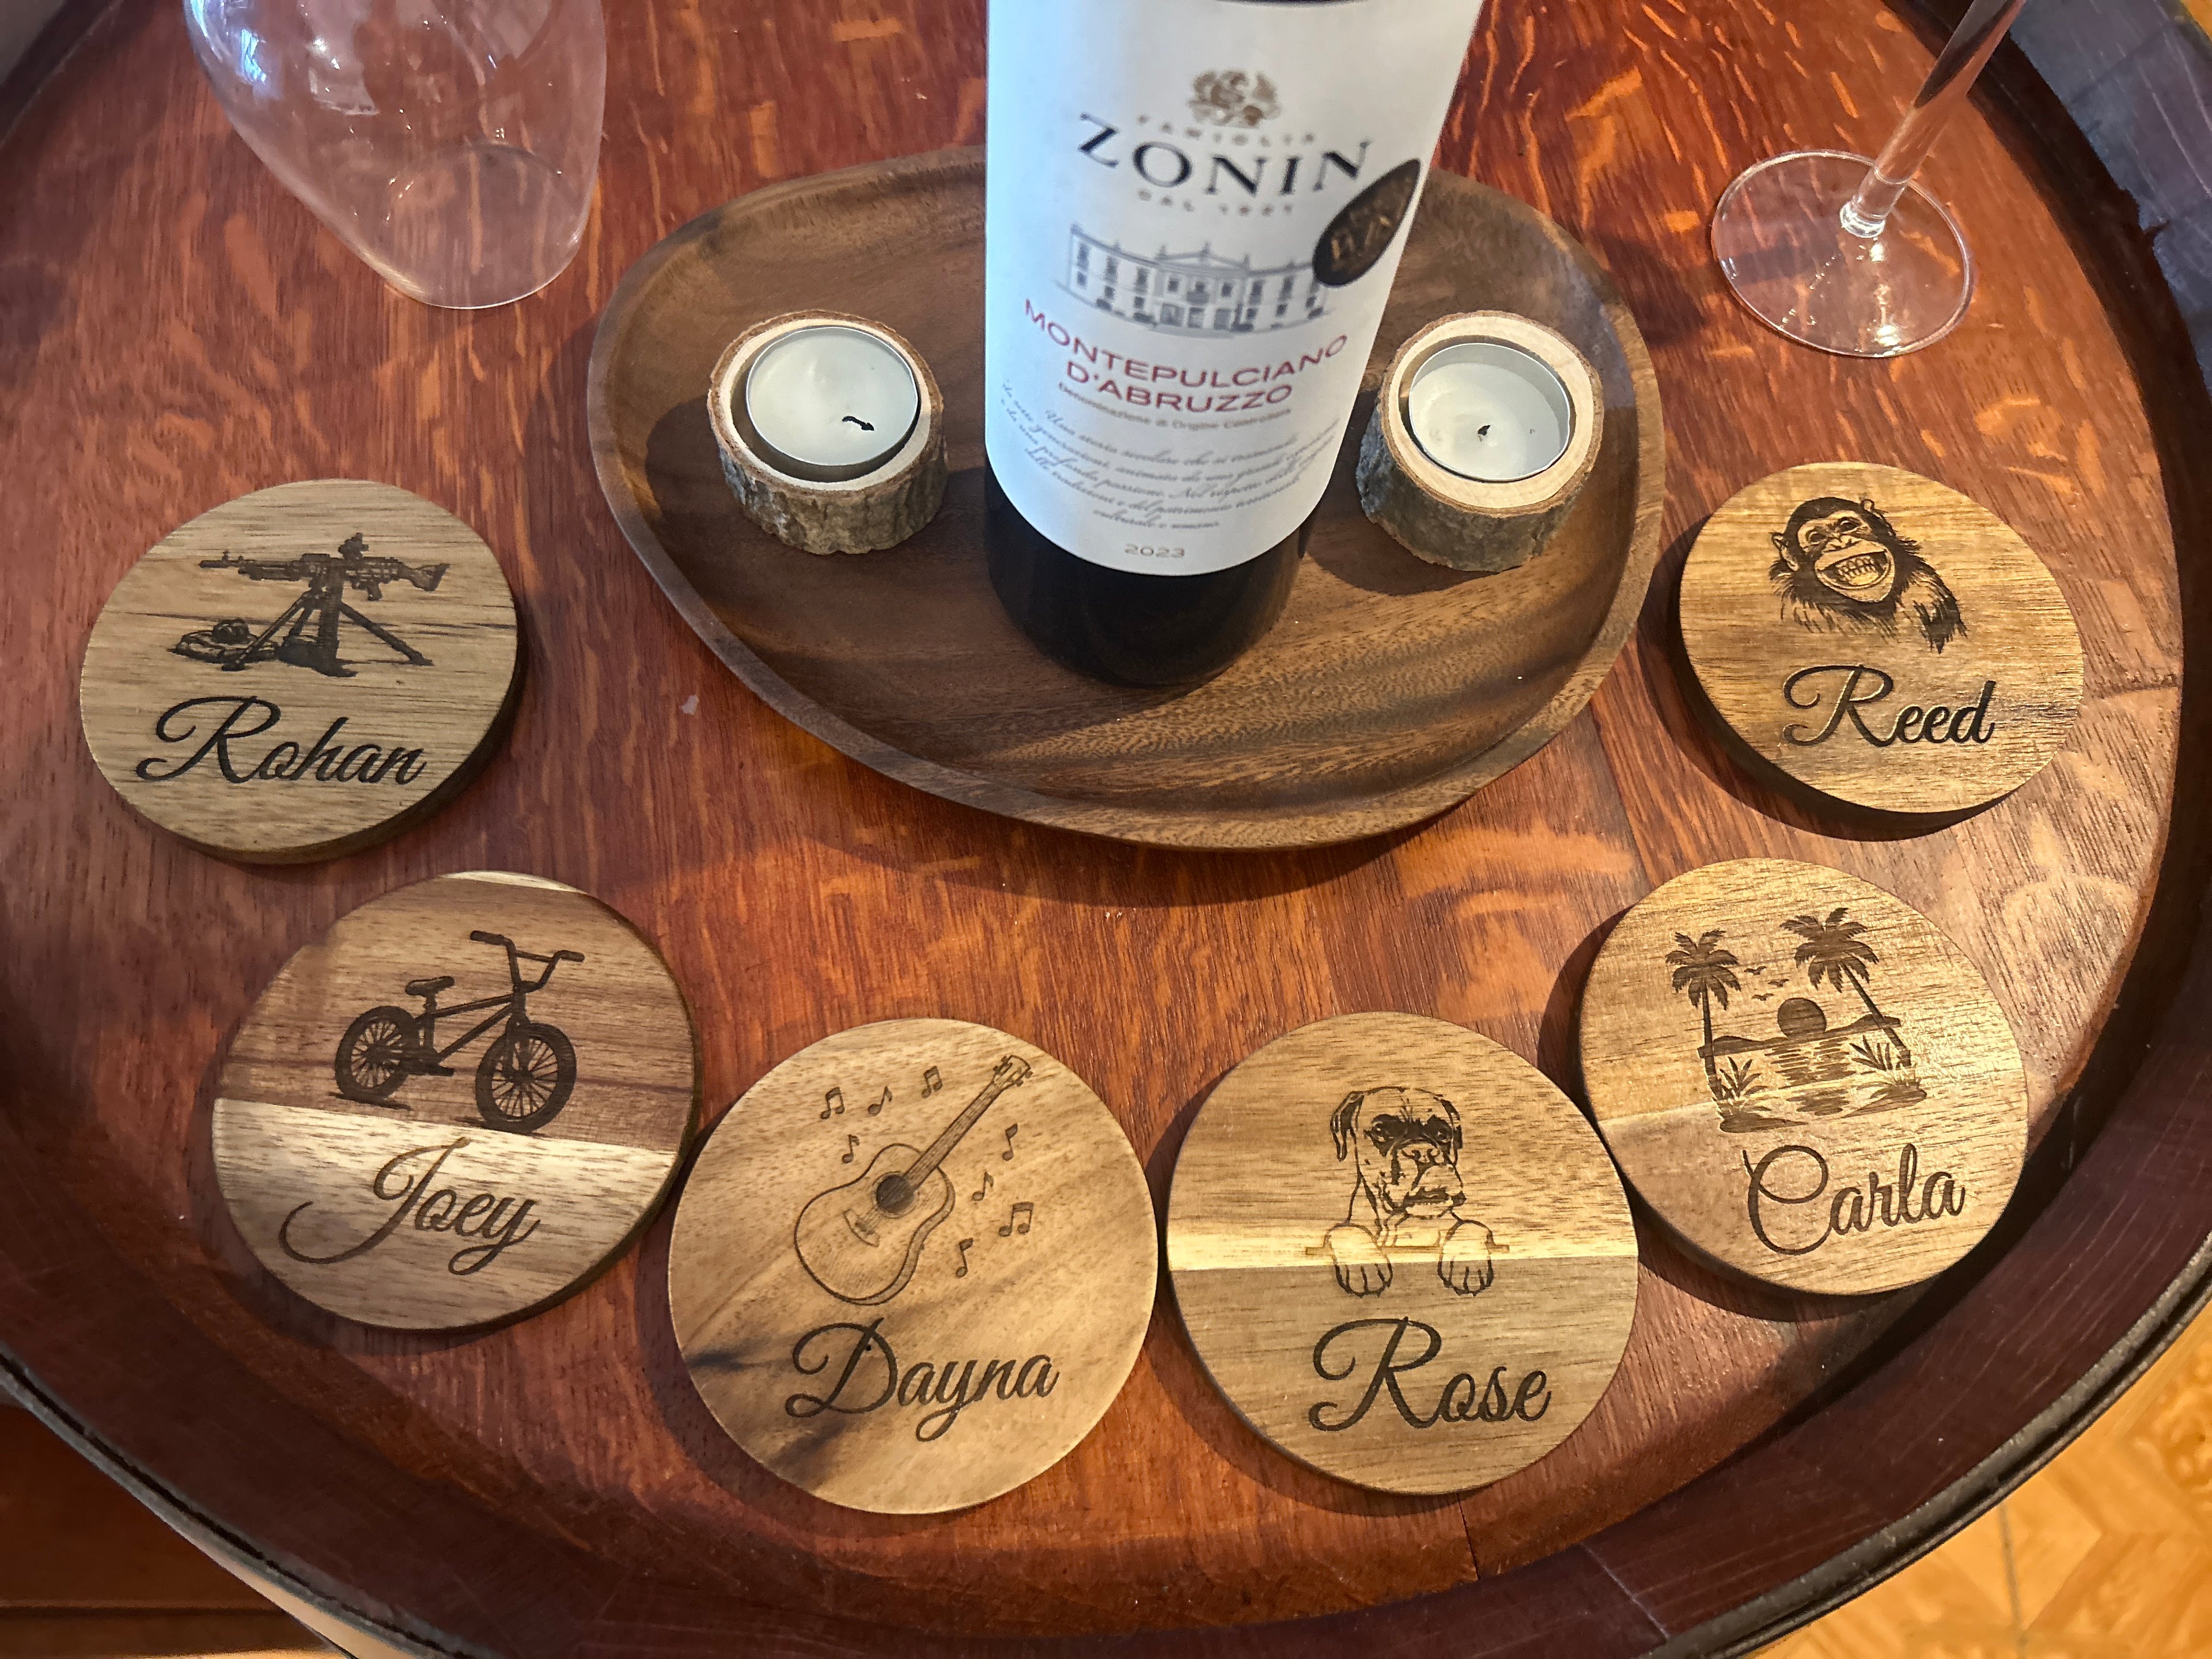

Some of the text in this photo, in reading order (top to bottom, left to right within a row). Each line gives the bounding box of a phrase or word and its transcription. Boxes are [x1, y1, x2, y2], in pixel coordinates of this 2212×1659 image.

[1079, 113, 1373, 196] ZONIN
[1024, 297, 1348, 389] MONTEPULCIANO
[1067, 360, 1293, 414] D'ABRUZZO
[1124, 543, 1185, 559] 2023
[135, 695, 427, 784] Rohan
[1782, 664, 1997, 748] Reed
[278, 1137, 541, 1277] Joey
[1742, 1142, 1965, 1256] Carla
[785, 1317, 1060, 1443] Dayna
[1308, 1316, 1552, 1432] Rose
